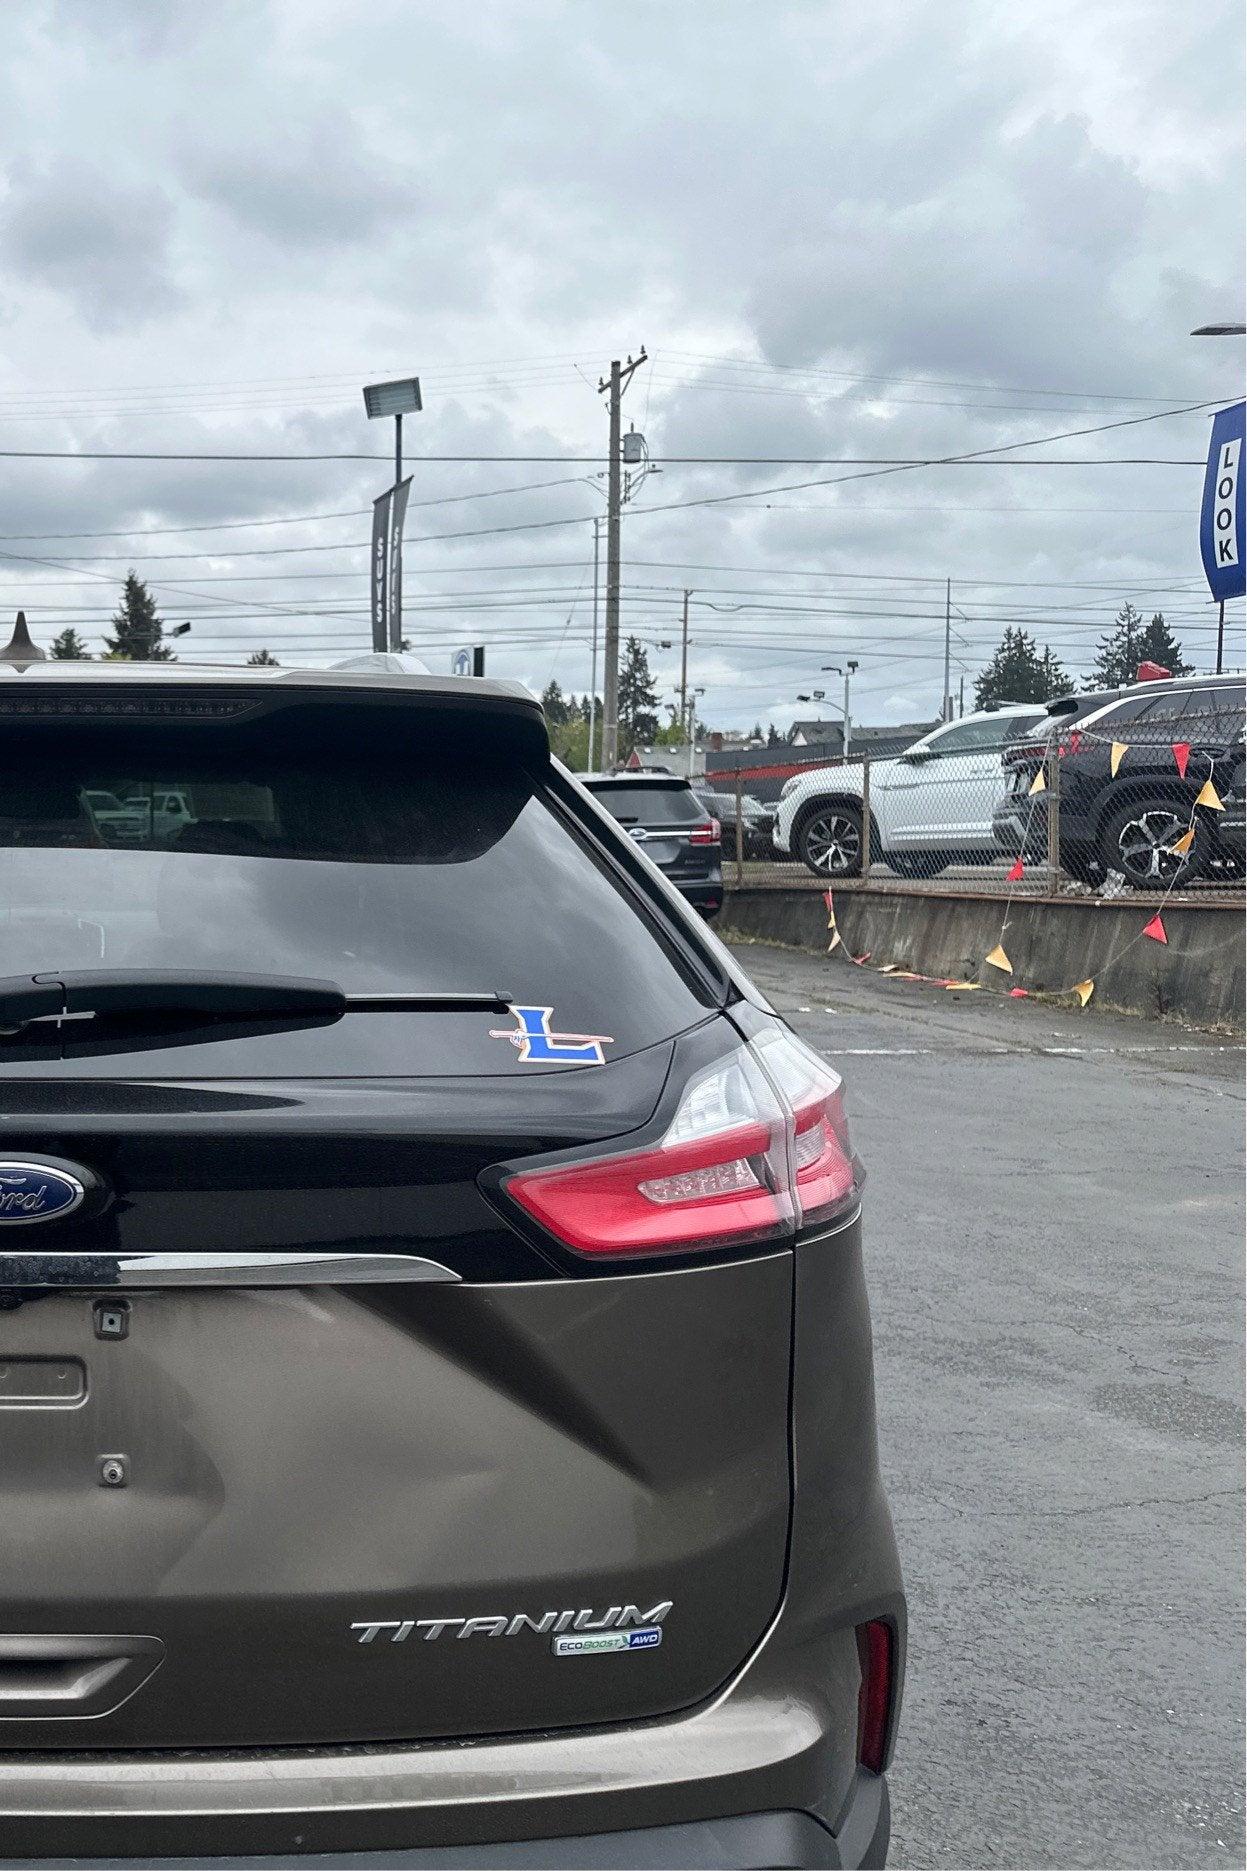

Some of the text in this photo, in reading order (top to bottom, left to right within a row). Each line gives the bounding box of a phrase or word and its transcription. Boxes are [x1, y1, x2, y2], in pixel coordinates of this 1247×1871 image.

[1217, 447, 1234, 562] LOOK
[350, 1600, 674, 1643] TITANIUM
[631, 1633, 658, 1645] AWD
